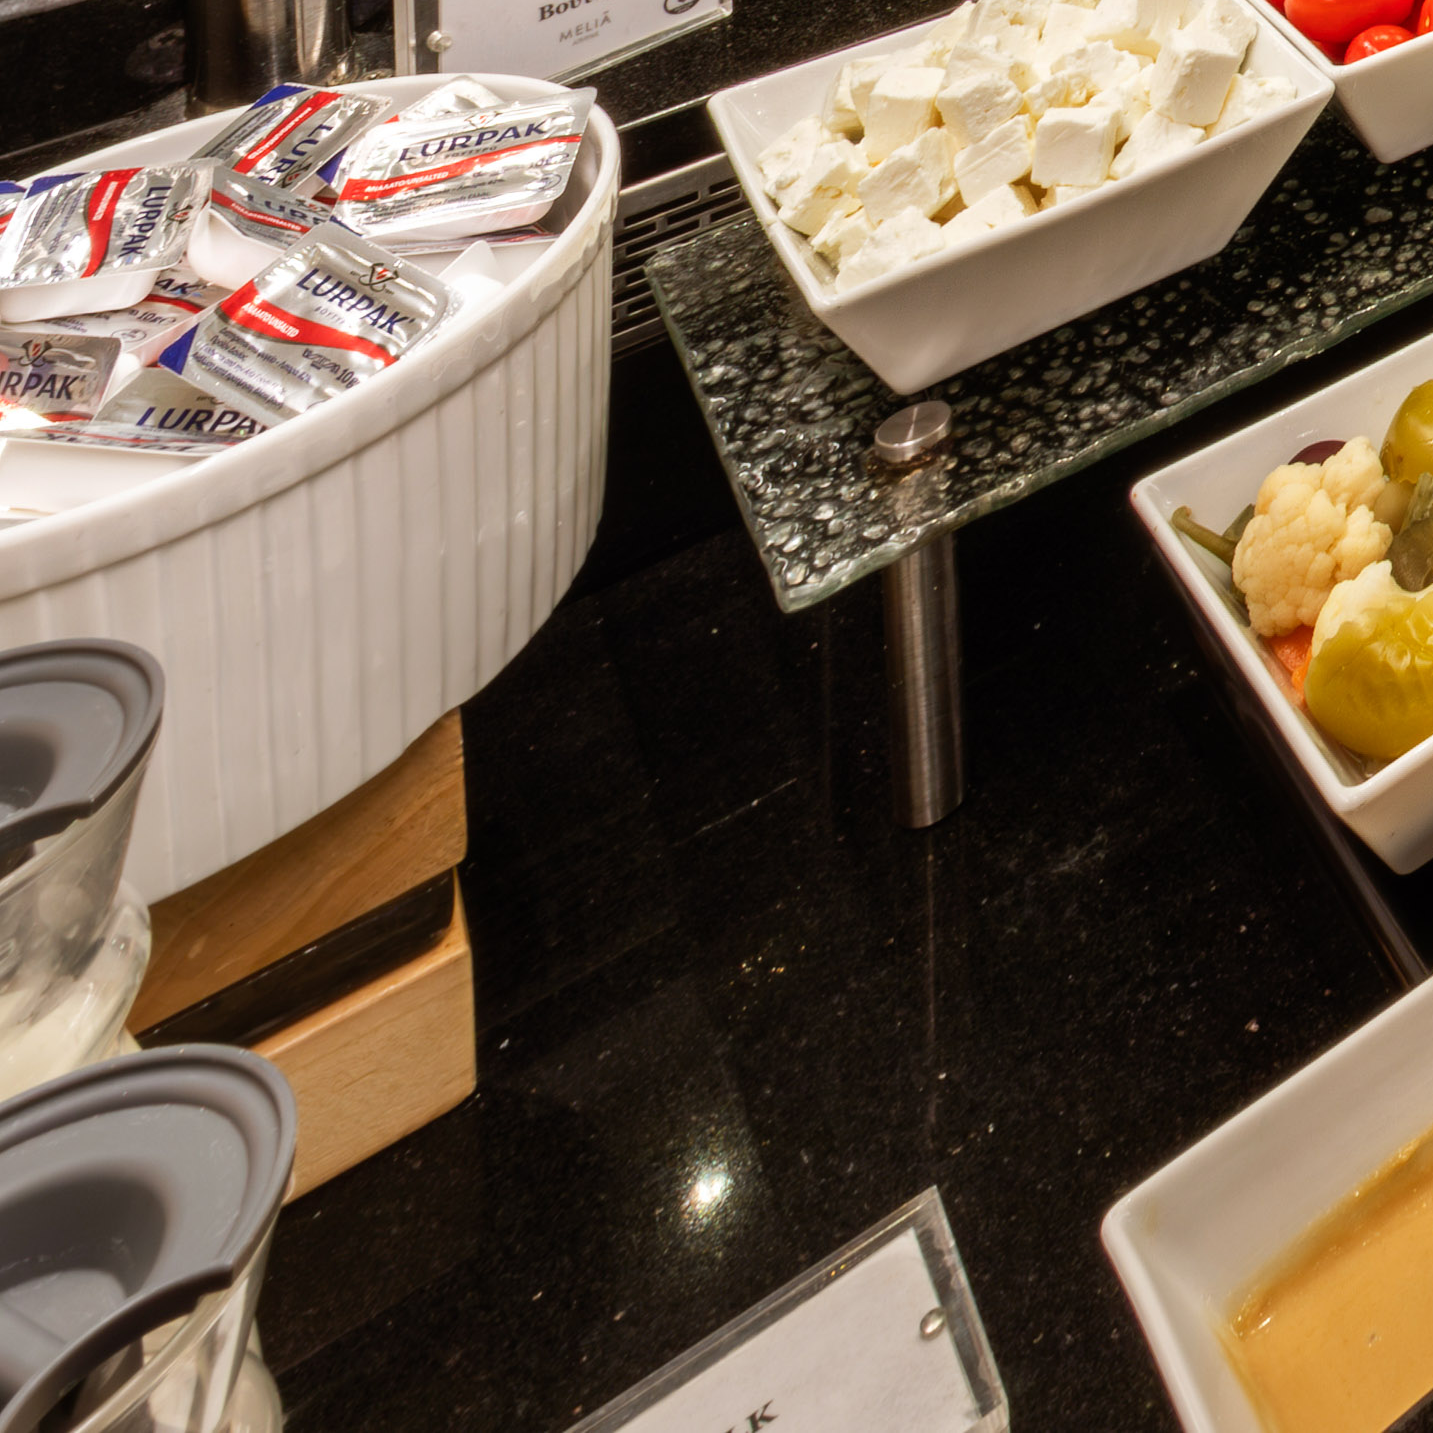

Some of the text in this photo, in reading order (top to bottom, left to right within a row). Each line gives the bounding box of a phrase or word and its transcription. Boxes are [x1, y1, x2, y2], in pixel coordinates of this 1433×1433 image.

[399, 119, 549, 163] LURPAK
[118, 186, 172, 258] LURPAK
[296, 267, 409, 336] LURPAK
